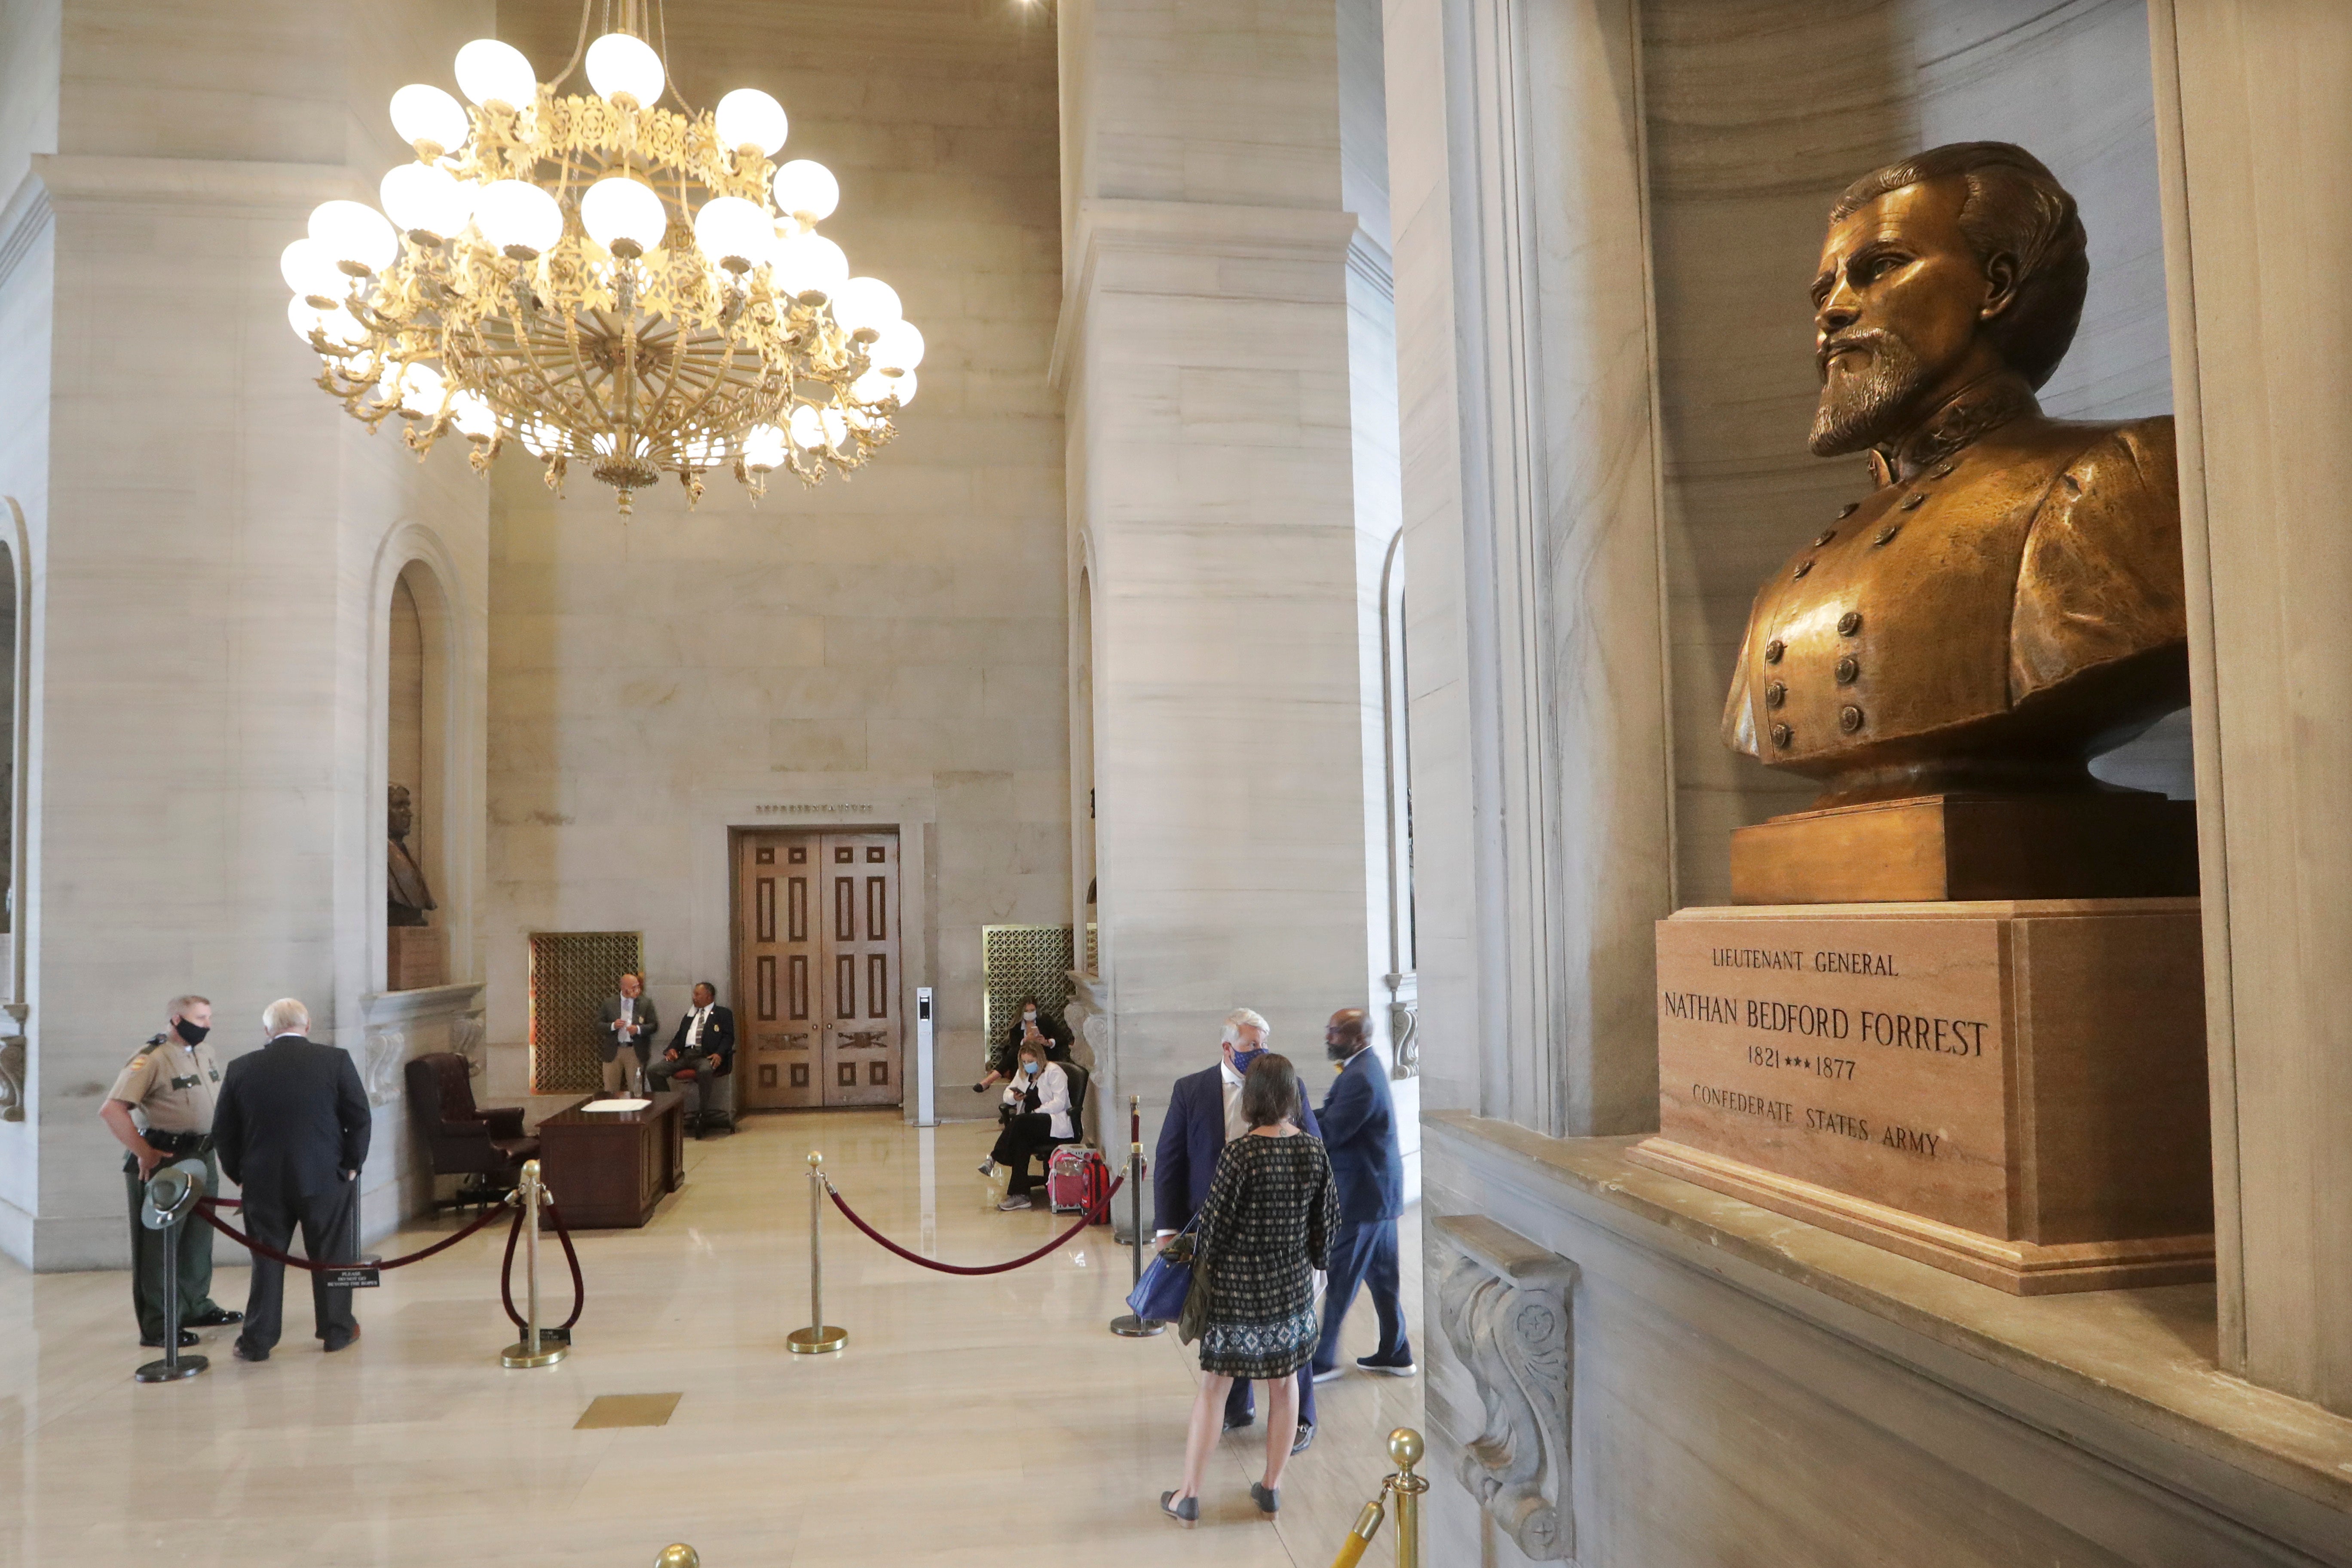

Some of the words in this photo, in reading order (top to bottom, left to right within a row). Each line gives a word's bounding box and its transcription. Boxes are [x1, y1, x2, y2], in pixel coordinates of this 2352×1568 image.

[1712, 948, 1803, 971] LIEUTENANT
[1815, 951, 1899, 977] GENERAL
[1665, 992, 1737, 1024] NATHAN
[1747, 1000, 1849, 1039] BEDFORD
[1861, 1011, 1988, 1057] FORREST
[1693, 1084, 1793, 1122] CONFEDERATE
[1806, 1109, 1869, 1140] STATES
[1883, 1126, 1942, 1157] ARMY
